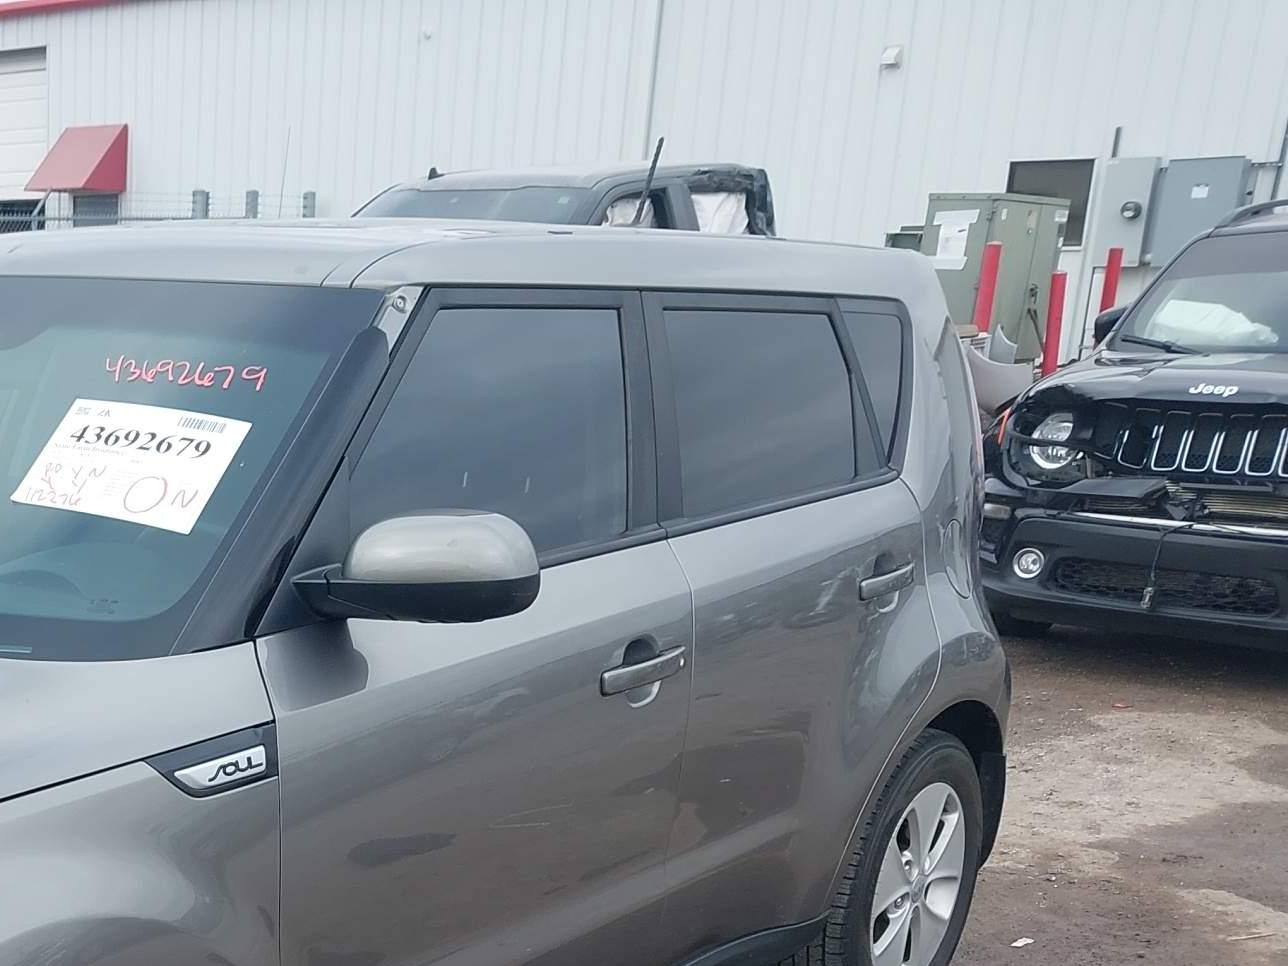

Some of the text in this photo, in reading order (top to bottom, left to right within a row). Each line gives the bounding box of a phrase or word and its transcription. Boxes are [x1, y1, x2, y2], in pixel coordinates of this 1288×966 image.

[106, 355, 268, 391] 43692679
[1188, 383, 1240, 398] Jeep
[70, 424, 212, 460] 43692679
